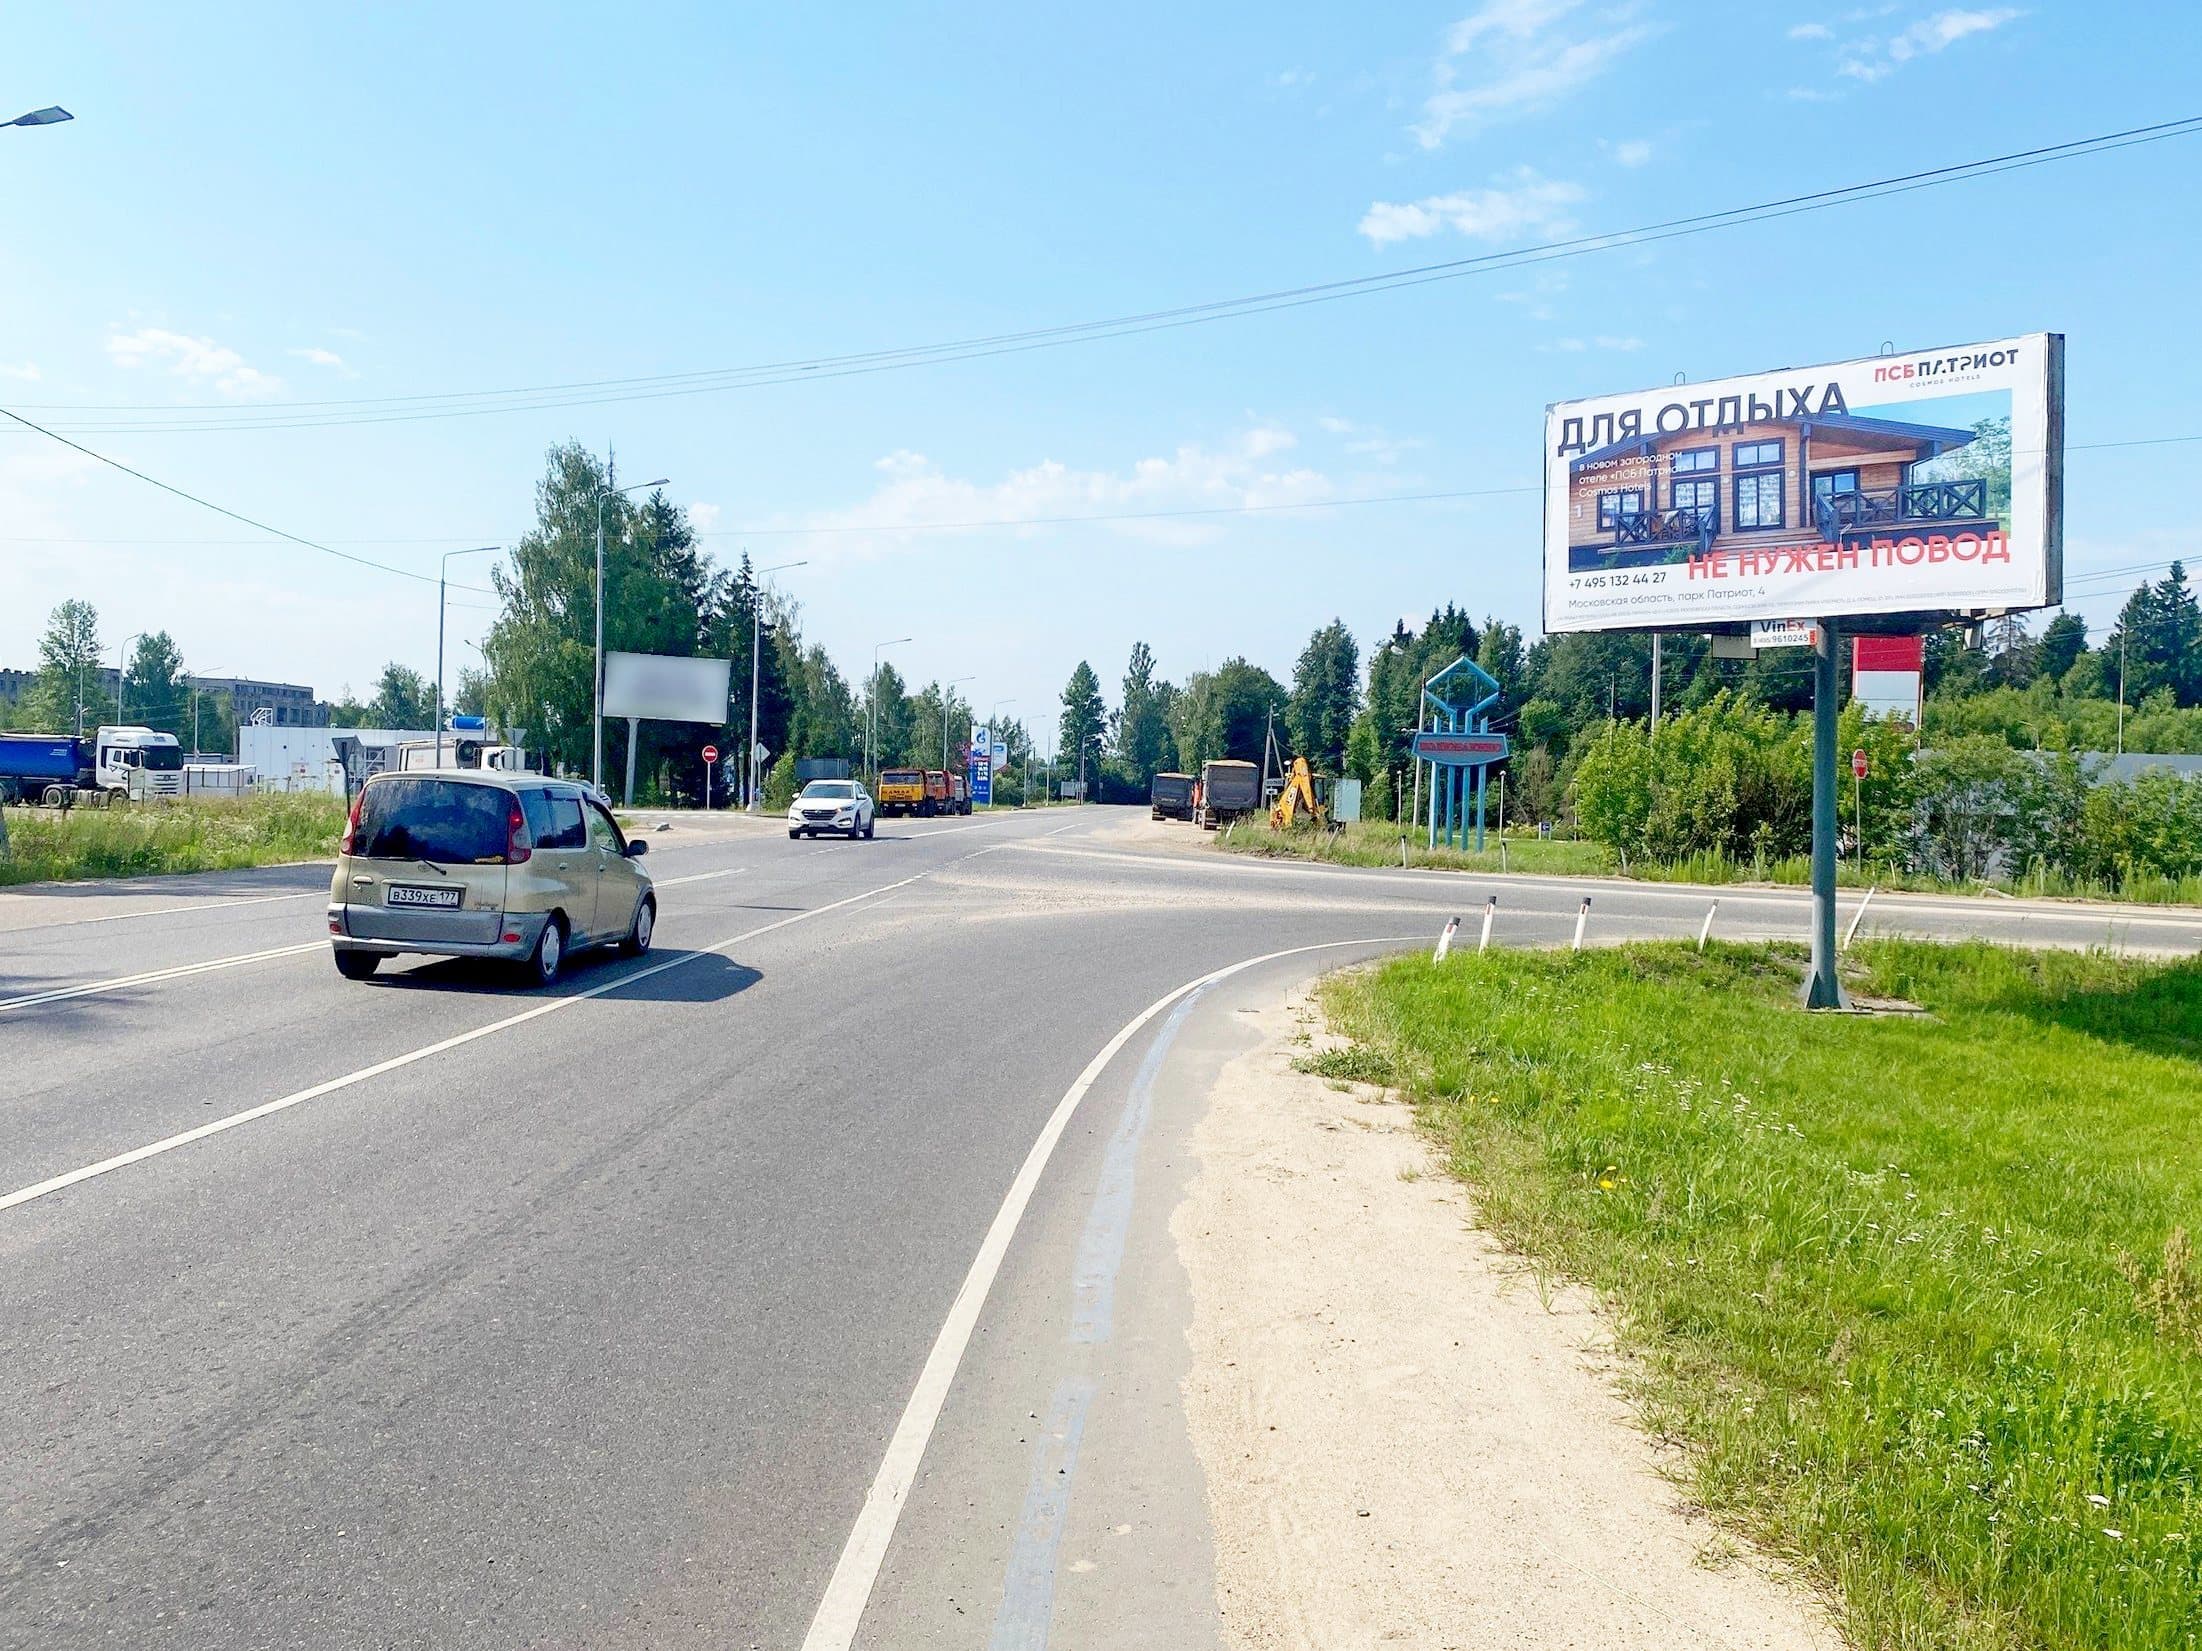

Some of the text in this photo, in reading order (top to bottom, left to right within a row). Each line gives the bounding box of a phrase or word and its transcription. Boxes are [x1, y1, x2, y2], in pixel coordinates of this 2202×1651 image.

[1558, 382, 1850, 457] ДЛЯ ОТДЫХА
[1587, 460, 1617, 470] новом
[1620, 451, 1682, 466] загородном
[1579, 473, 1608, 485] отеле
[1579, 480, 1652, 498] Cosmos Hotels
[1688, 531, 2011, 580] НЕ НУЖЕН ПОВОД
[1569, 571, 1667, 590] +7 495 132 44 27
[1568, 586, 1766, 609] Московская область, парк Патриот, 4
[1760, 619, 1806, 632] VinEx
[439, 891, 457, 901] 177
